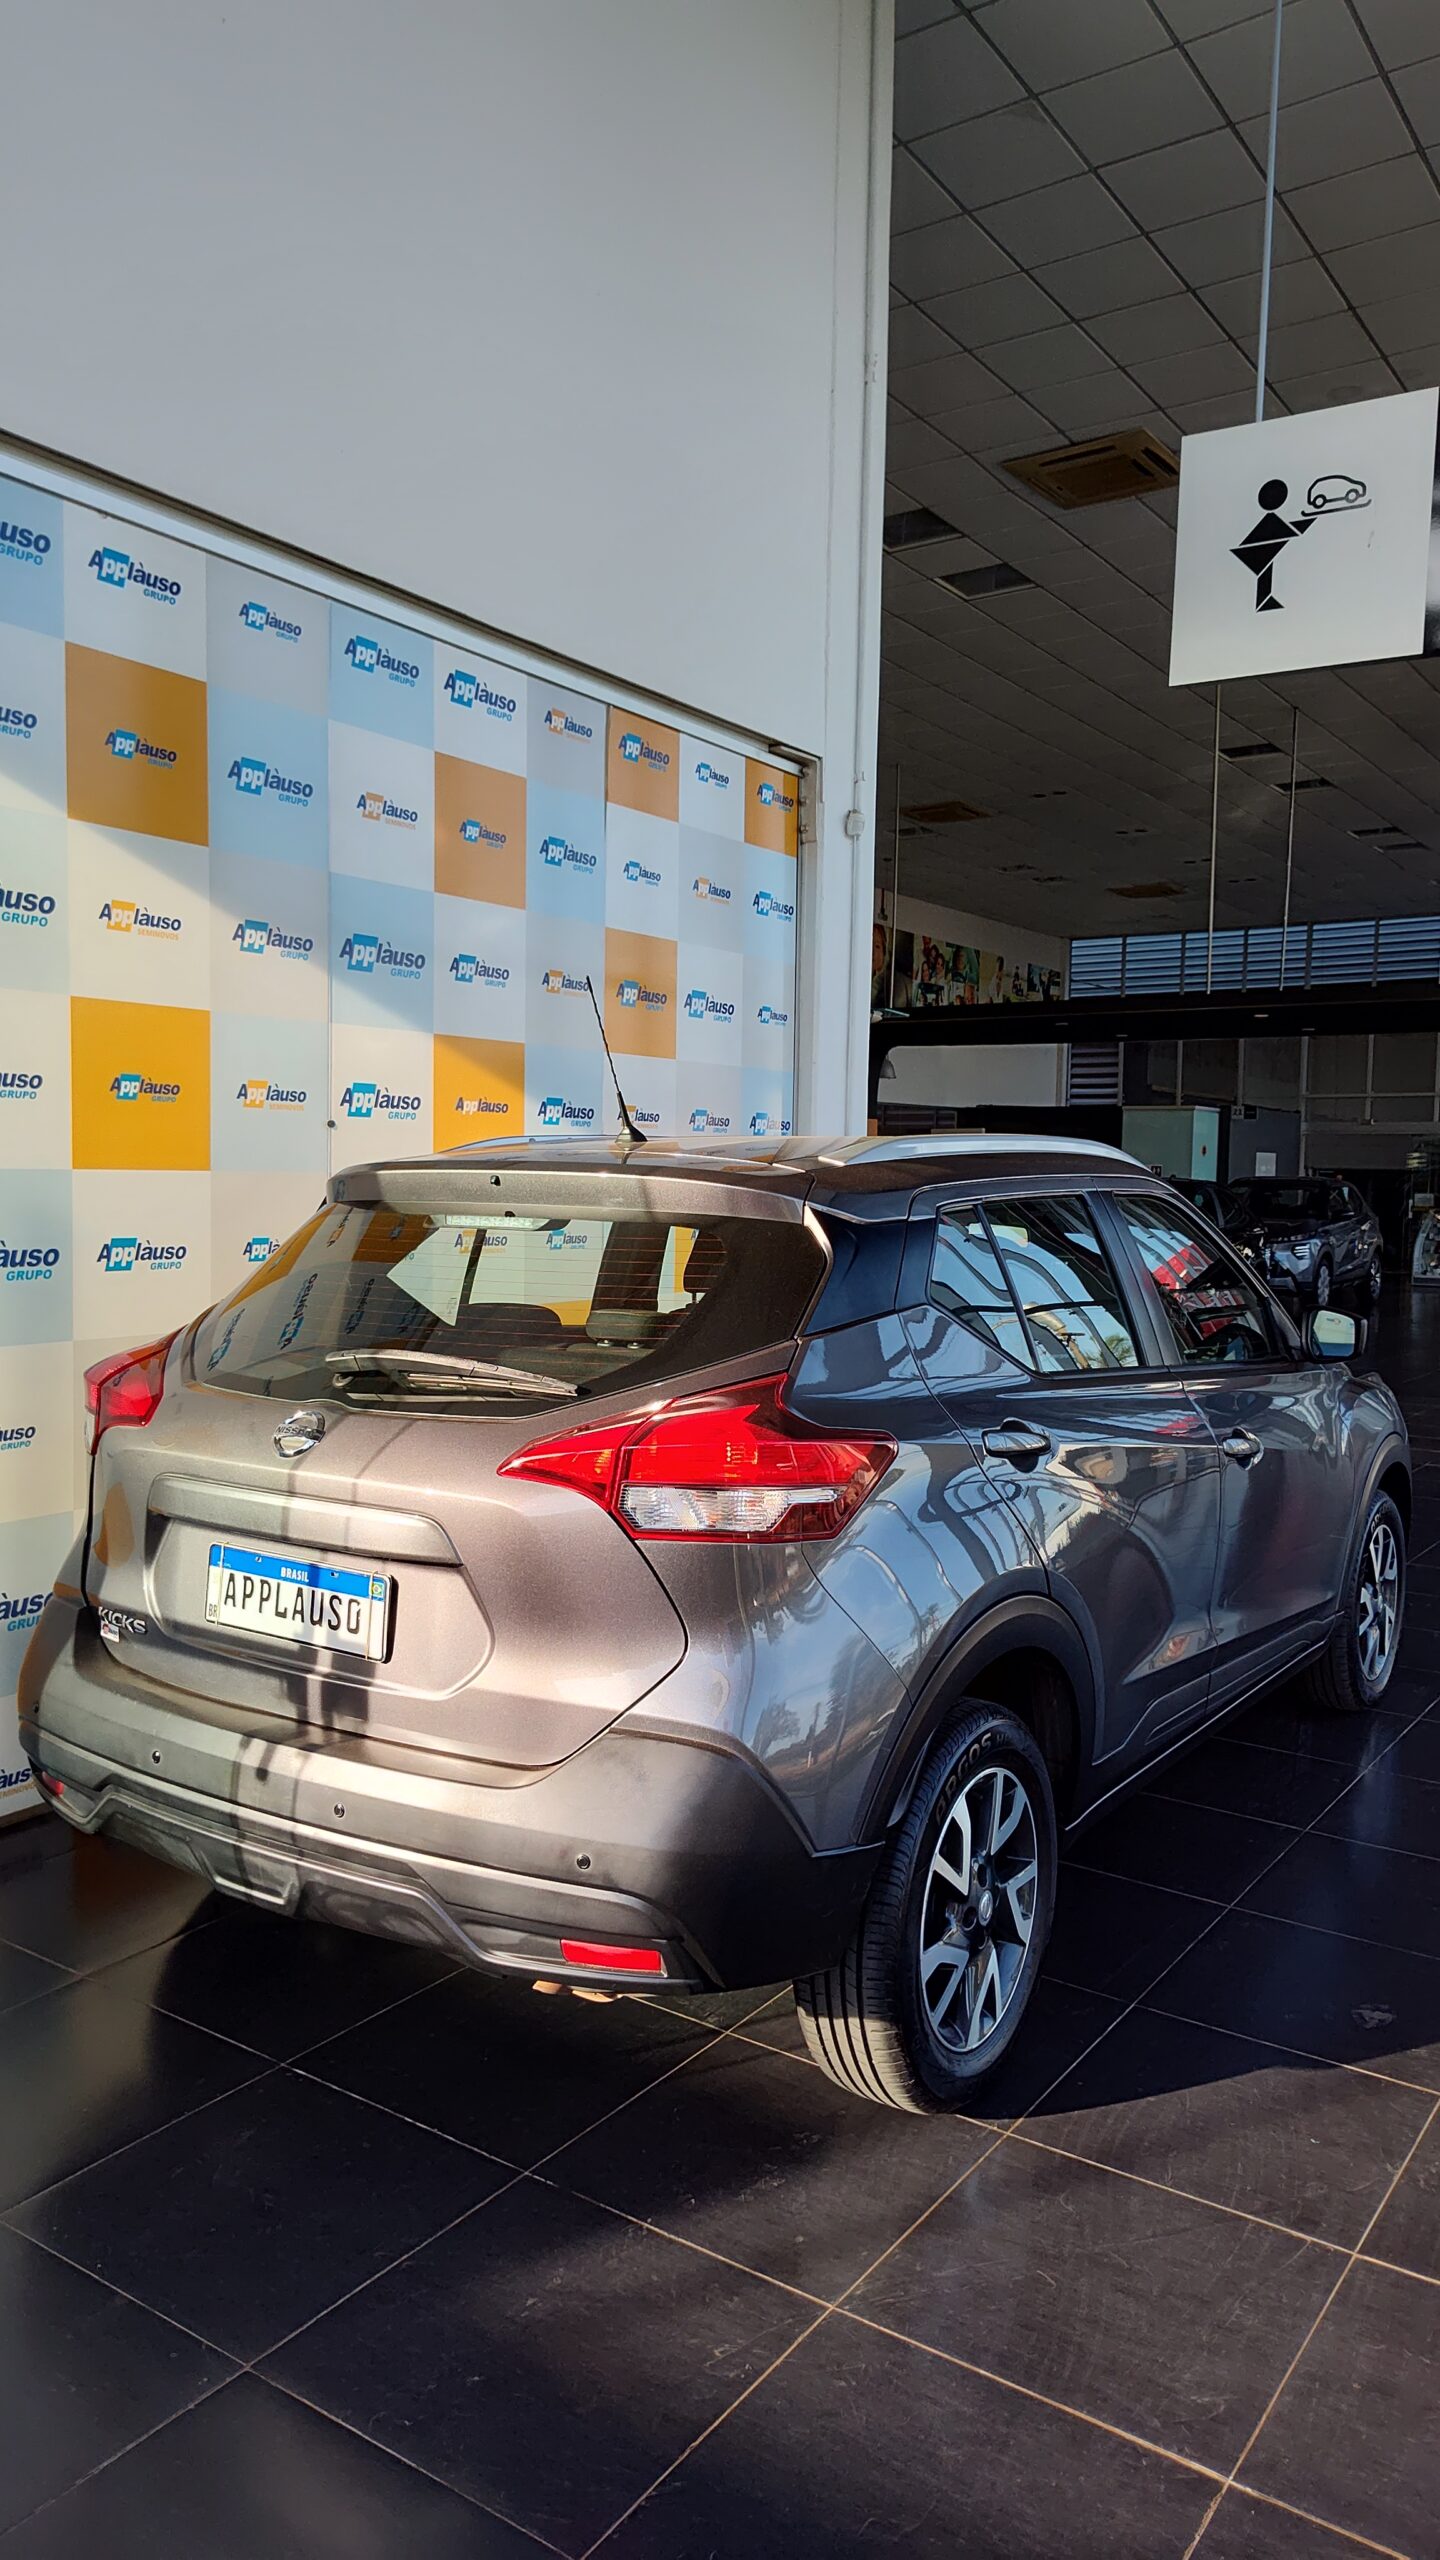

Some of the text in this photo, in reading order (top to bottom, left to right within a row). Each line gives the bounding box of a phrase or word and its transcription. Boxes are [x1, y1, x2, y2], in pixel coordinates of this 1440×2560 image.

[88, 548, 181, 597] Applàuso
[143, 588, 176, 605] GRUPO
[239, 602, 302, 637] Applàuso
[344, 637, 420, 679] Applàuso
[388, 673, 415, 688] GRUPO
[444, 672, 516, 713] Applàuso
[487, 708, 512, 722] GRUPO
[544, 710, 592, 738] Applàuso
[105, 731, 177, 763] Applàuso
[619, 735, 669, 765] Applàuso
[228, 759, 313, 799] Applàuso
[695, 763, 729, 785] Applàuso
[278, 793, 309, 808] GRUPO
[356, 794, 418, 822] Applàuso
[459, 821, 506, 844] Applàuso
[539, 838, 597, 867] Applàuso
[623, 862, 661, 882] Applàuso
[693, 879, 731, 900] Applàuso
[1, 911, 48, 928] GRUPO
[98, 902, 182, 931] Applàuso
[232, 922, 313, 952] Applàuso
[280, 949, 309, 962] GRUPO
[339, 937, 426, 970] Applàuso
[390, 967, 421, 980] GRUPO
[449, 956, 510, 981] Applàuso
[616, 982, 667, 1005] Applàuso
[684, 993, 734, 1016] Applàuso
[0, 1089, 37, 1100] GRUPO
[110, 1076, 180, 1096] Applàuso
[237, 1083, 306, 1103] Applàuso
[151, 1094, 176, 1103] GRUPO
[340, 1087, 421, 1110] Applàuso
[455, 1097, 509, 1115] Applàuso
[388, 1110, 416, 1120] GRUPO
[537, 1100, 594, 1120] Applàuso
[689, 1112, 730, 1128] Applàuso
[97, 1240, 187, 1270] Applàuso
[150, 1260, 182, 1271] GRUPO
[6, 1268, 53, 1282] GRUPO
[1, 1440, 31, 1451] GRUPO
[280, 1566, 309, 1583] BRASIL
[208, 1603, 218, 1617] BR
[224, 1572, 361, 1635] APPLAUSO
[98, 1606, 147, 1634] KICKS
